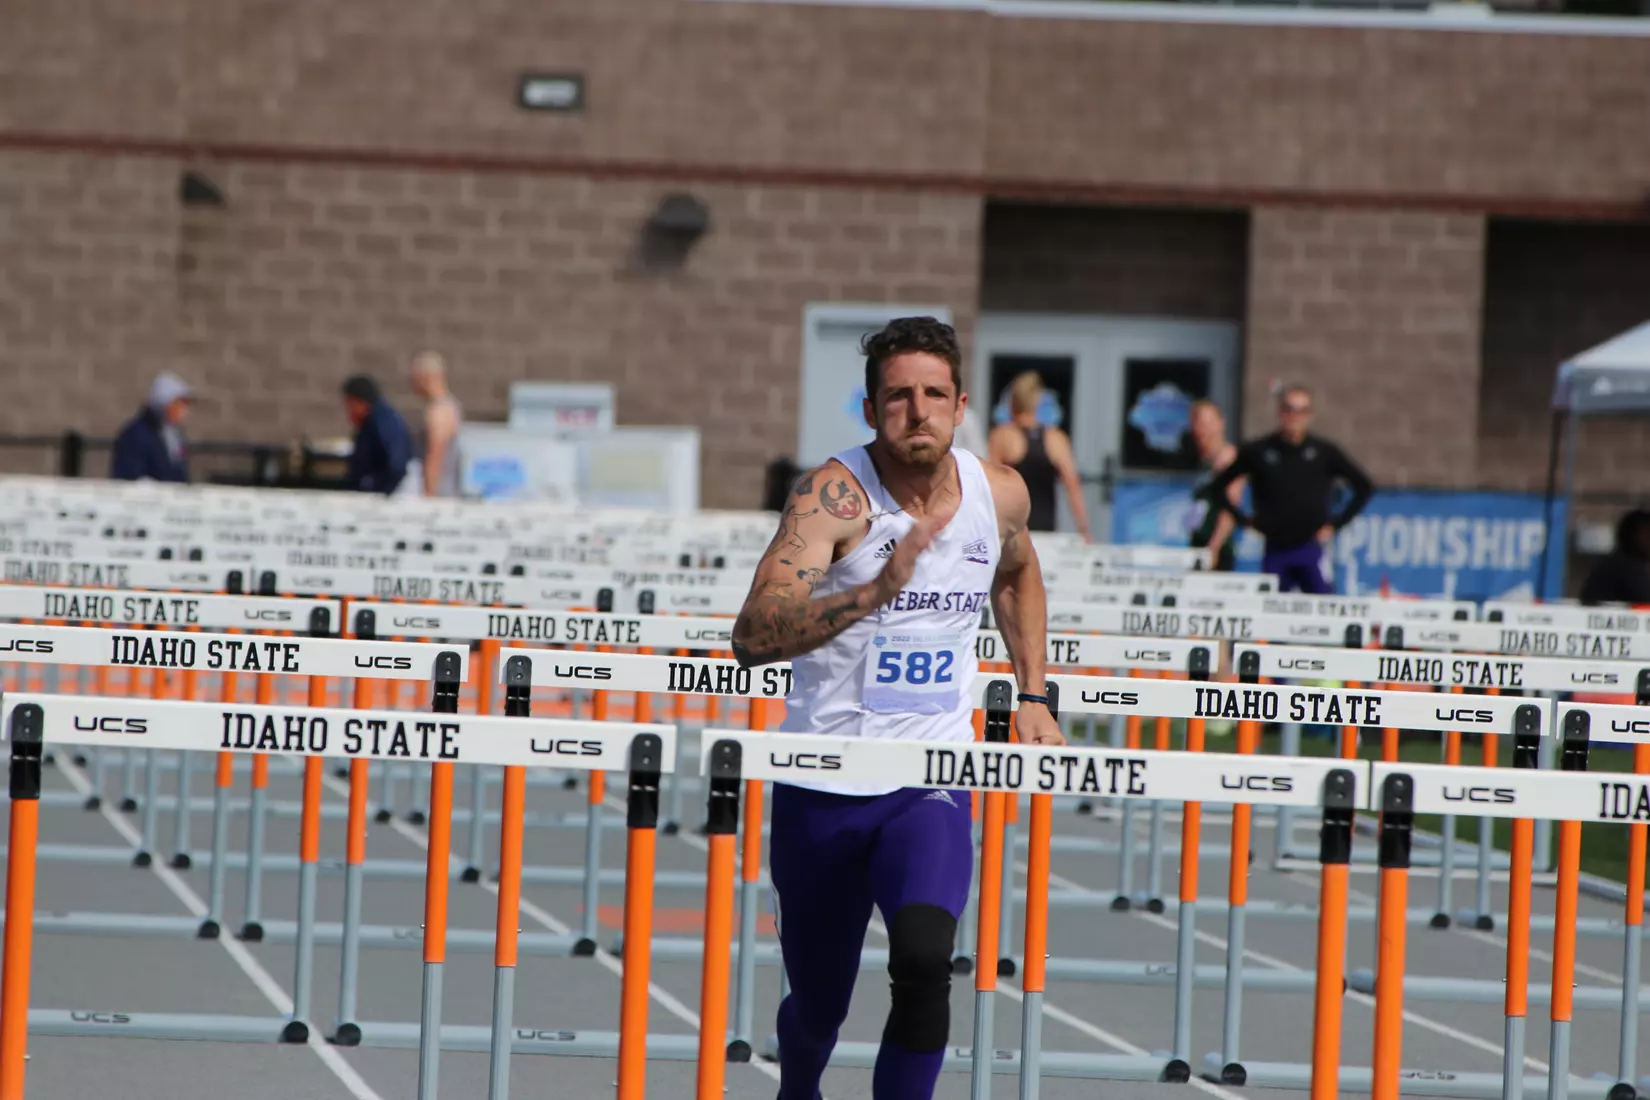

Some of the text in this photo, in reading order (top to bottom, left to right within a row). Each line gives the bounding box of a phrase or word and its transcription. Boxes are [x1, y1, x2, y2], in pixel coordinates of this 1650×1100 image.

[3, 560, 131, 587] IDAHO STATE
[373, 578, 505, 604] IDAHO STATE
[42, 593, 199, 623] IDAHO STATE
[887, 591, 940, 611] EBER
[244, 609, 292, 622] UCS
[393, 616, 441, 629] UCS
[488, 614, 641, 644] IDAHO STATE
[1121, 611, 1253, 638] IDAHO STATE
[684, 629, 731, 641] UCS
[1500, 630, 1632, 657] IDAHO STATE
[111, 636, 299, 671] IDAHO STATE
[355, 655, 411, 669] UCS
[1124, 650, 1171, 662] UCS
[555, 665, 611, 679] UCS
[876, 650, 953, 685] 582
[1278, 658, 1325, 671] UCS
[1378, 657, 1523, 686] IDAHO STATE
[668, 663, 751, 694] IDAHO
[1571, 672, 1618, 684] UCS
[1082, 690, 1138, 705] UCS
[1195, 688, 1381, 724] IDAHO STATE
[1436, 708, 1493, 723] UCS
[74, 716, 147, 733] UCS
[221, 713, 461, 759] IDAHO STATE
[531, 738, 603, 756] UCS
[770, 752, 841, 769] UCS
[924, 750, 1146, 795] IDAHO STATE
[1221, 774, 1293, 791] UCS
[1443, 786, 1516, 803] UCS
[71, 1012, 131, 1024] UCS
[518, 1029, 576, 1041] UCS
